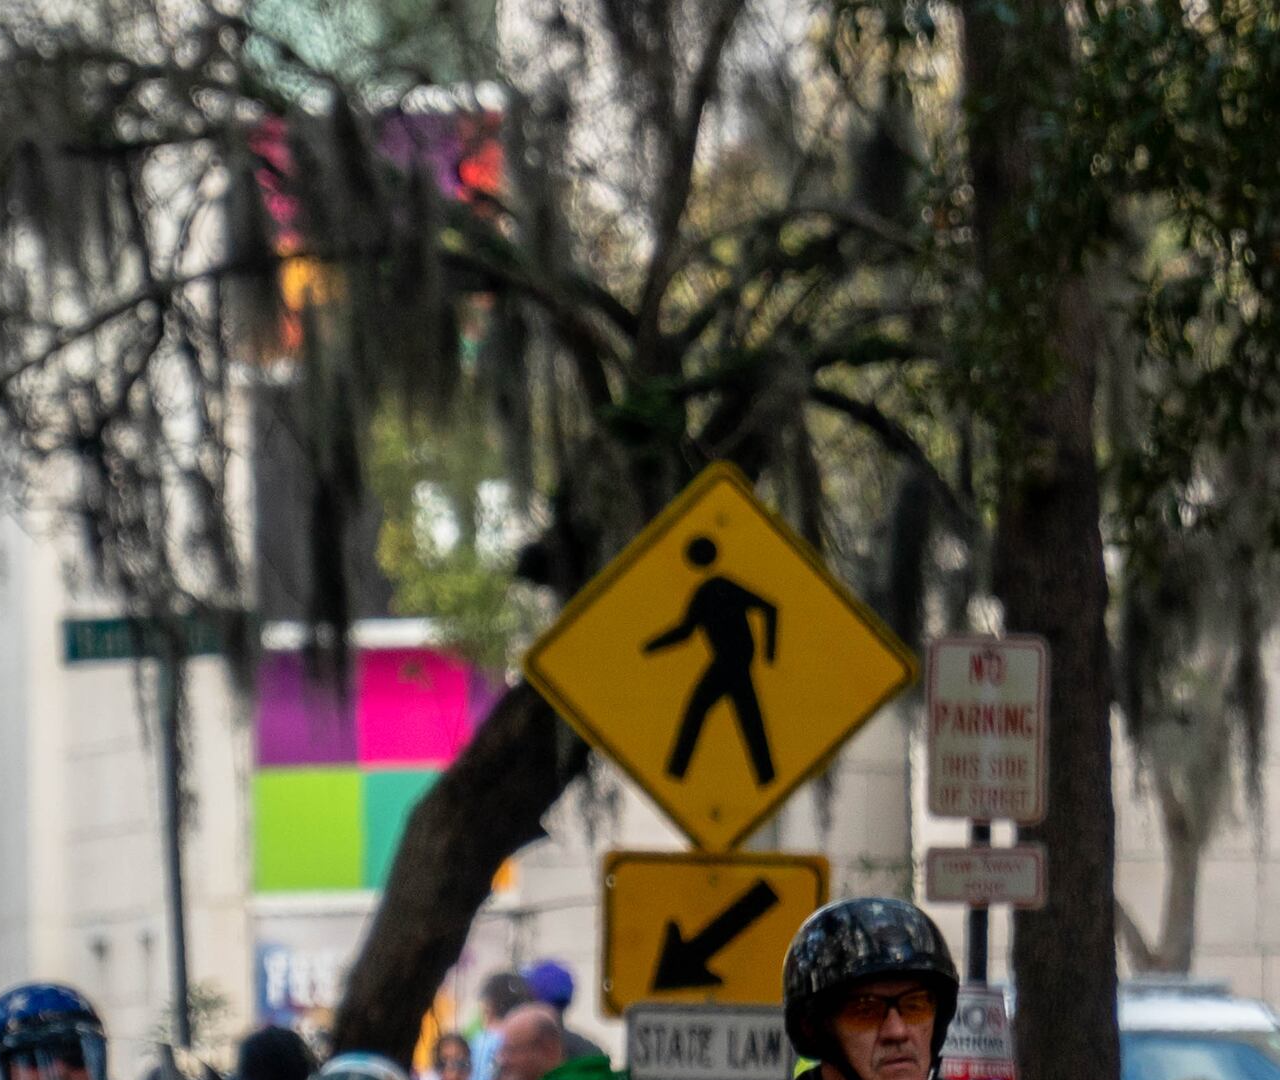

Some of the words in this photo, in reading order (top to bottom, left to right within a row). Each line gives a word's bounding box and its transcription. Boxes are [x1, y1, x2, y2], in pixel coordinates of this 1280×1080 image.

[969, 652, 1007, 685] NO
[934, 702, 1034, 738] PARKING
[637, 1024, 713, 1069] STATE
[726, 1026, 782, 1070] LAW
